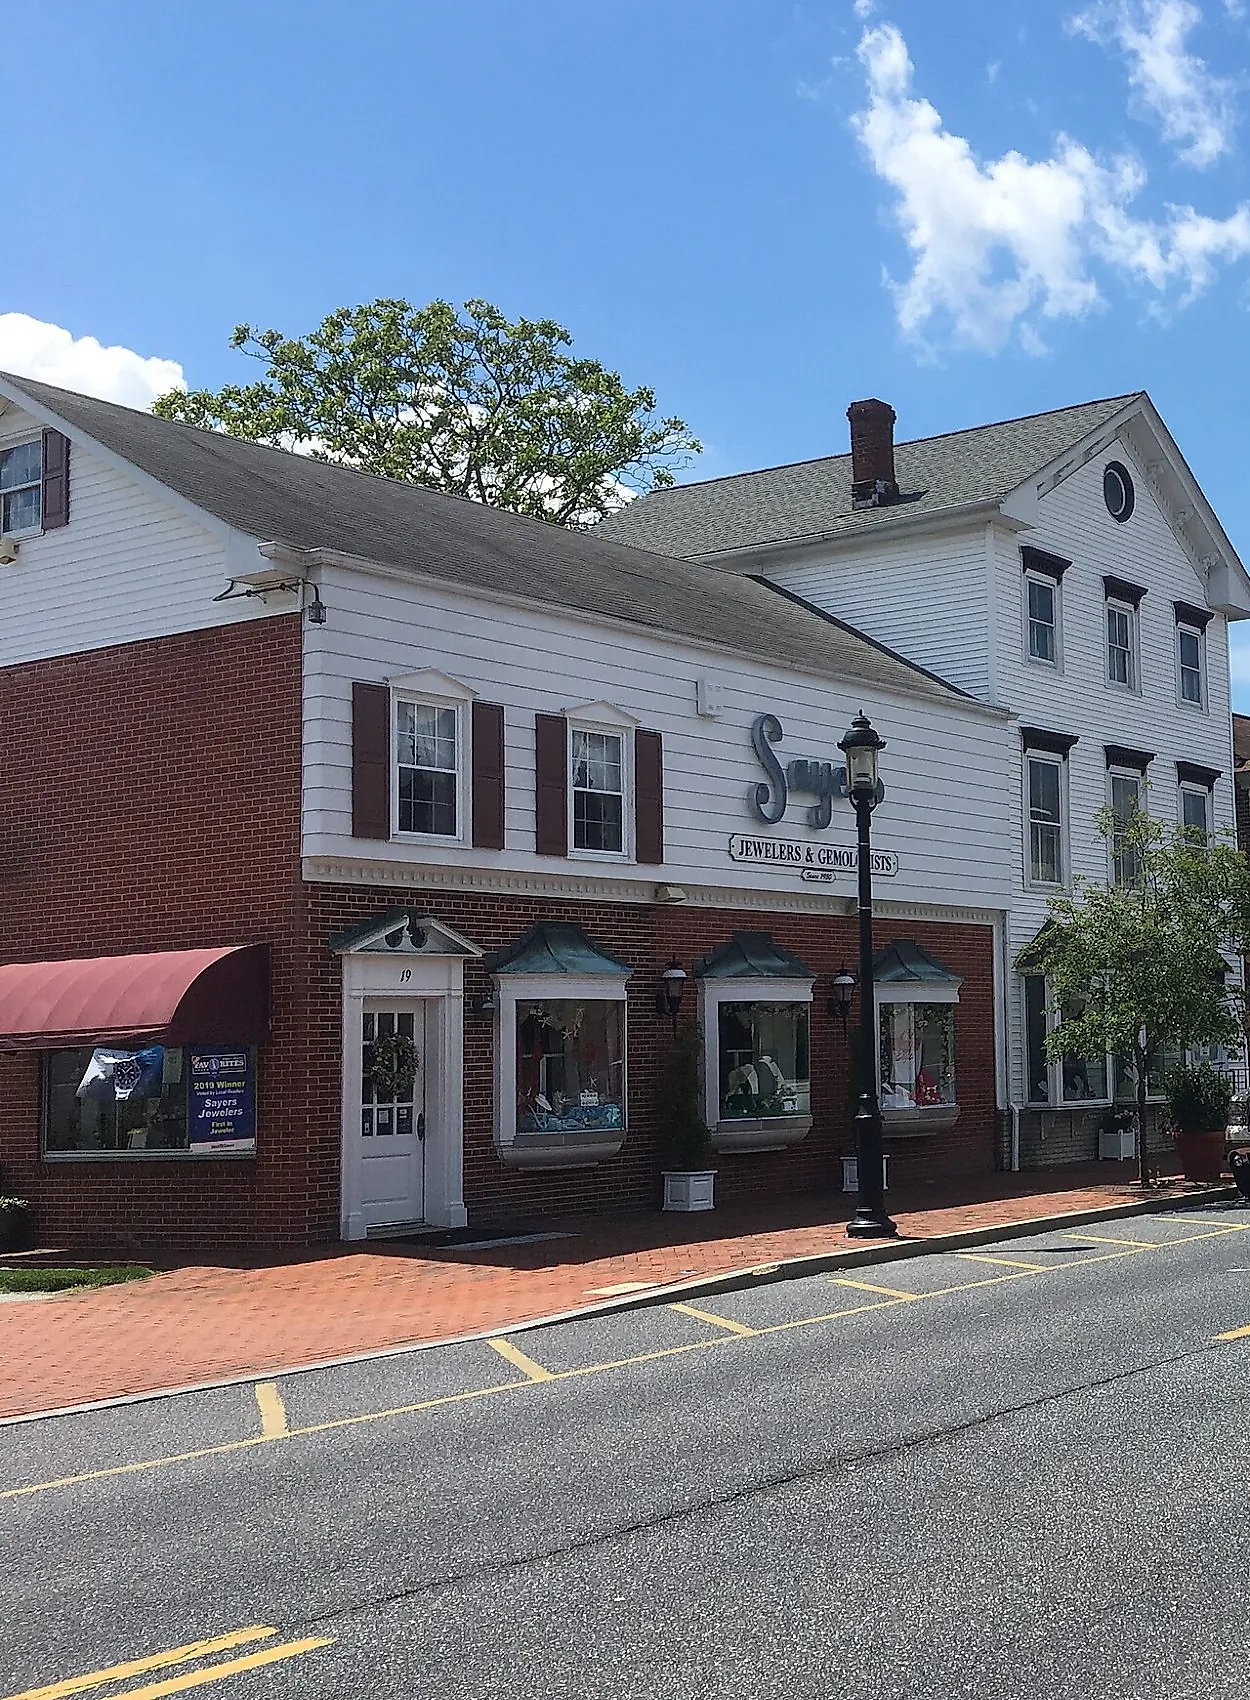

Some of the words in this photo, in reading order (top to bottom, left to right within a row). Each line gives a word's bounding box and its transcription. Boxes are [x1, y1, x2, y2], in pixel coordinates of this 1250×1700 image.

[739, 840, 801, 862] JEWELERS
[805, 846, 814, 864] &
[817, 848, 892, 872] GEMOLISTS
[400, 969, 411, 982] 19
[217, 1080, 245, 1089] Winner
[204, 1098, 237, 1108] Sayers
[198, 1107, 243, 1118] Jewelers
